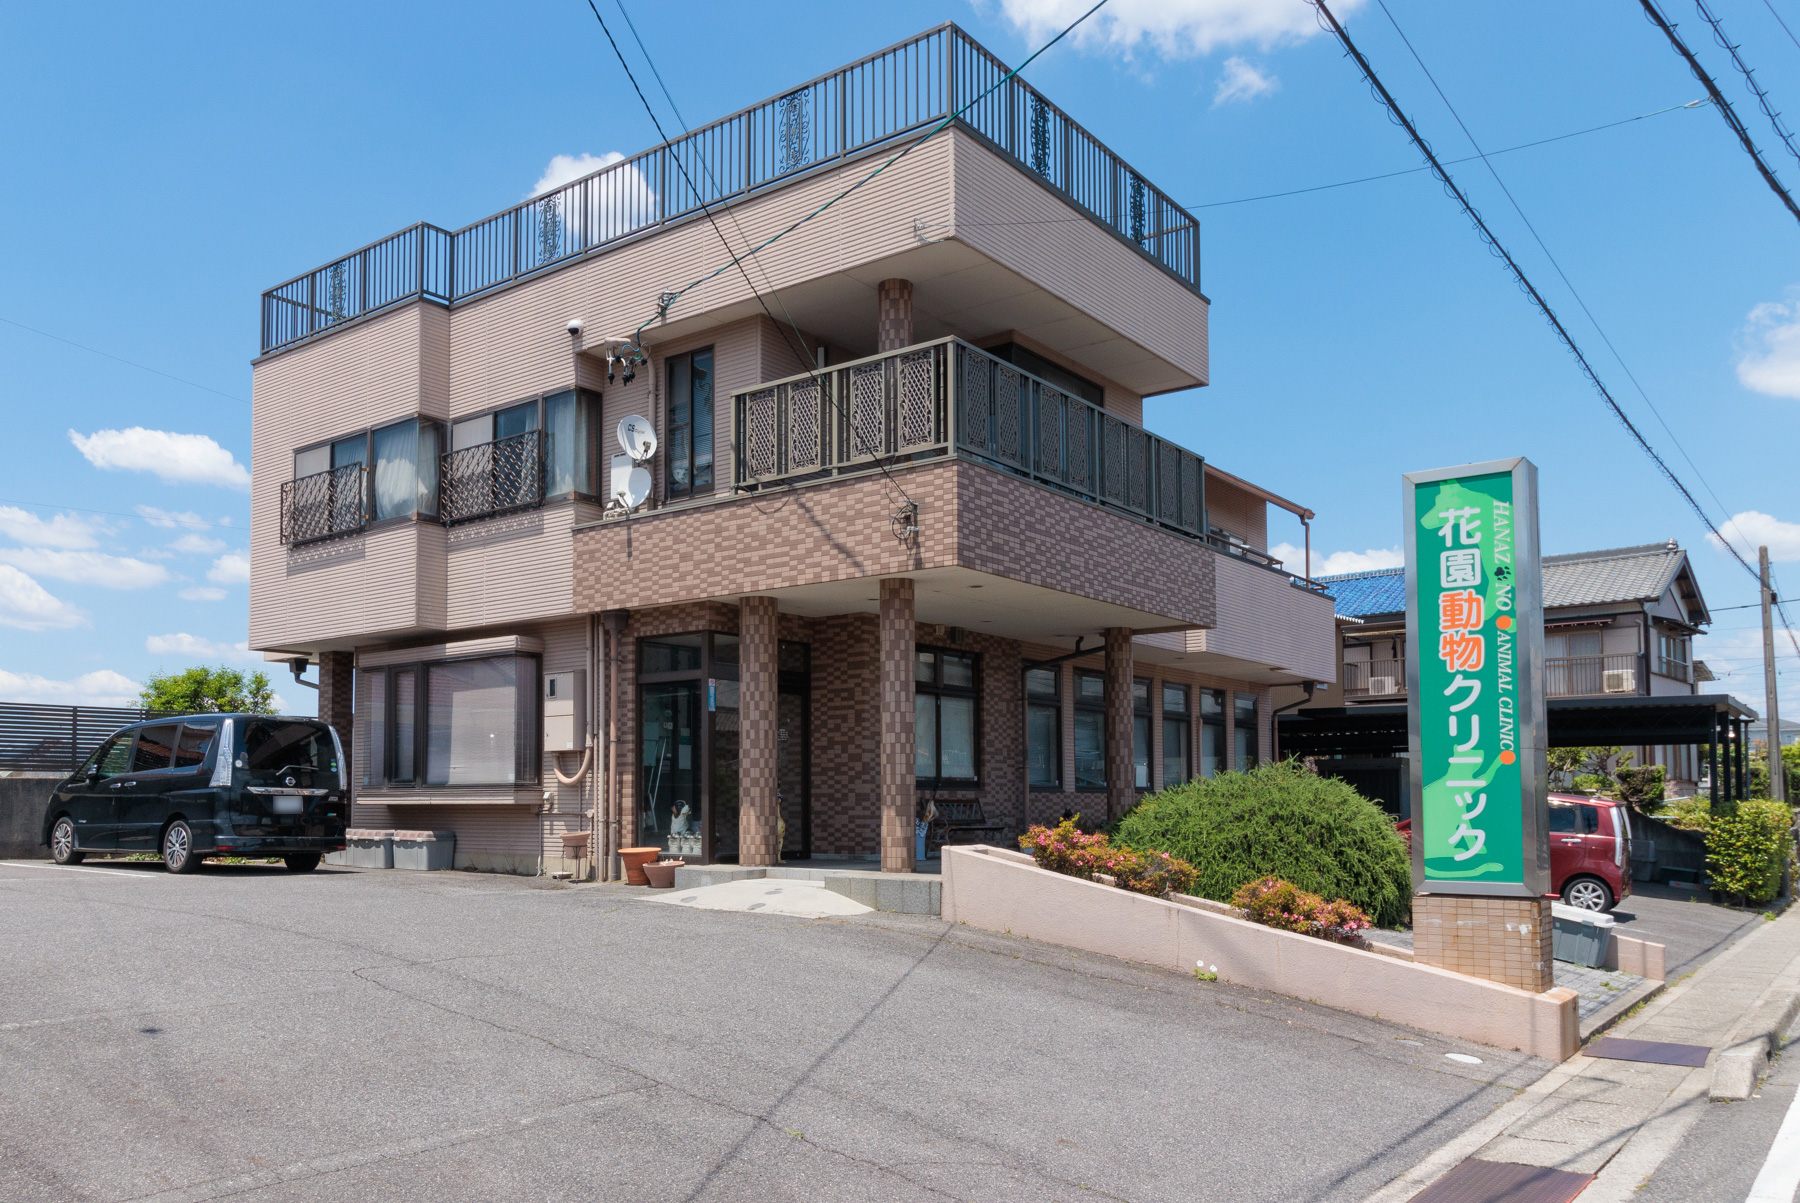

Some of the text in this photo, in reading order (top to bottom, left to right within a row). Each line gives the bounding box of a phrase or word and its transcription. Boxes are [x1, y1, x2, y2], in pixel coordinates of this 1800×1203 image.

[628, 424, 635, 432] CS
[1495, 582, 1512, 611] NO
[1438, 505, 1486, 861] 花園動物クリニック
[1497, 630, 1513, 693] ANIMAL
[1498, 696, 1514, 751] CLINIC
